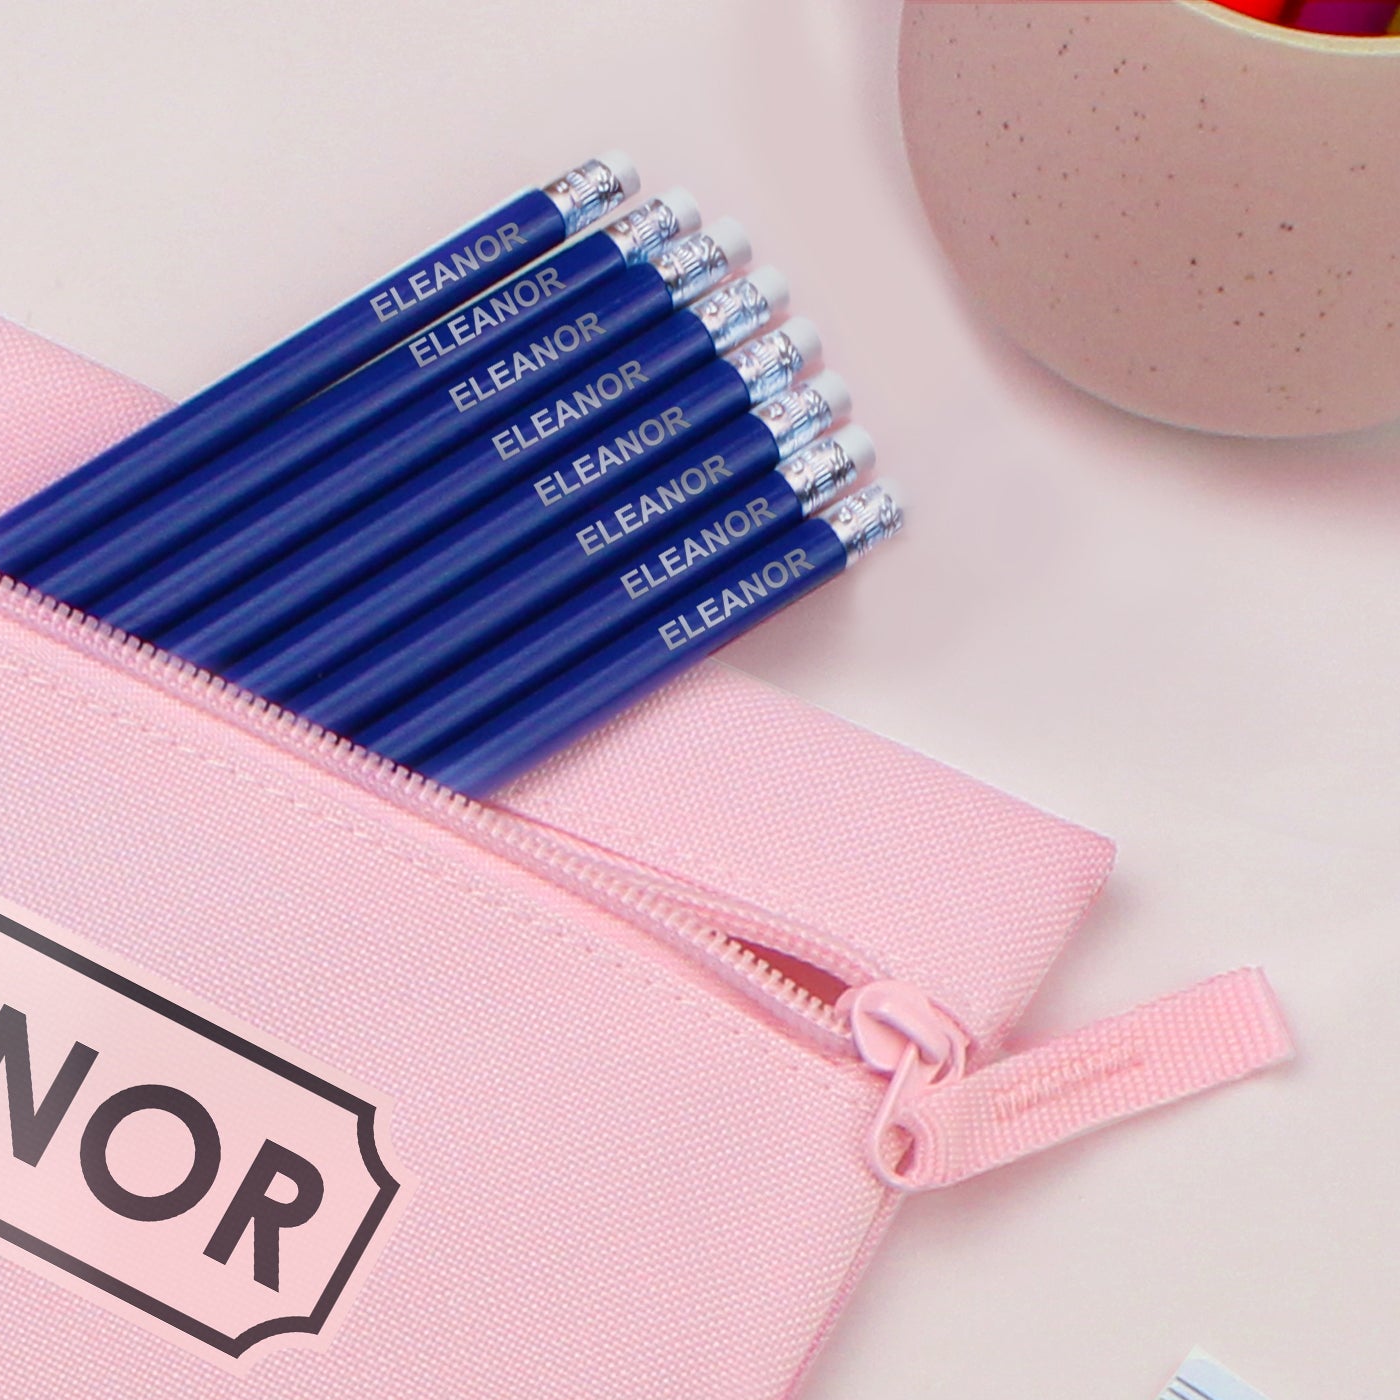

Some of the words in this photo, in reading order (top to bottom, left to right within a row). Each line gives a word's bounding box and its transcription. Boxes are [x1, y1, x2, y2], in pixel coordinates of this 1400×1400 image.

[370, 222, 528, 322] ELEANOR
[409, 268, 566, 368] ELEANOR
[449, 312, 606, 413] ELEANOR
[492, 361, 650, 460] ELEANOR
[534, 406, 692, 507] ELEANOR
[576, 455, 734, 556] ELEANOR
[620, 498, 777, 599] ELEANOR
[659, 548, 815, 651] ELEANOR
